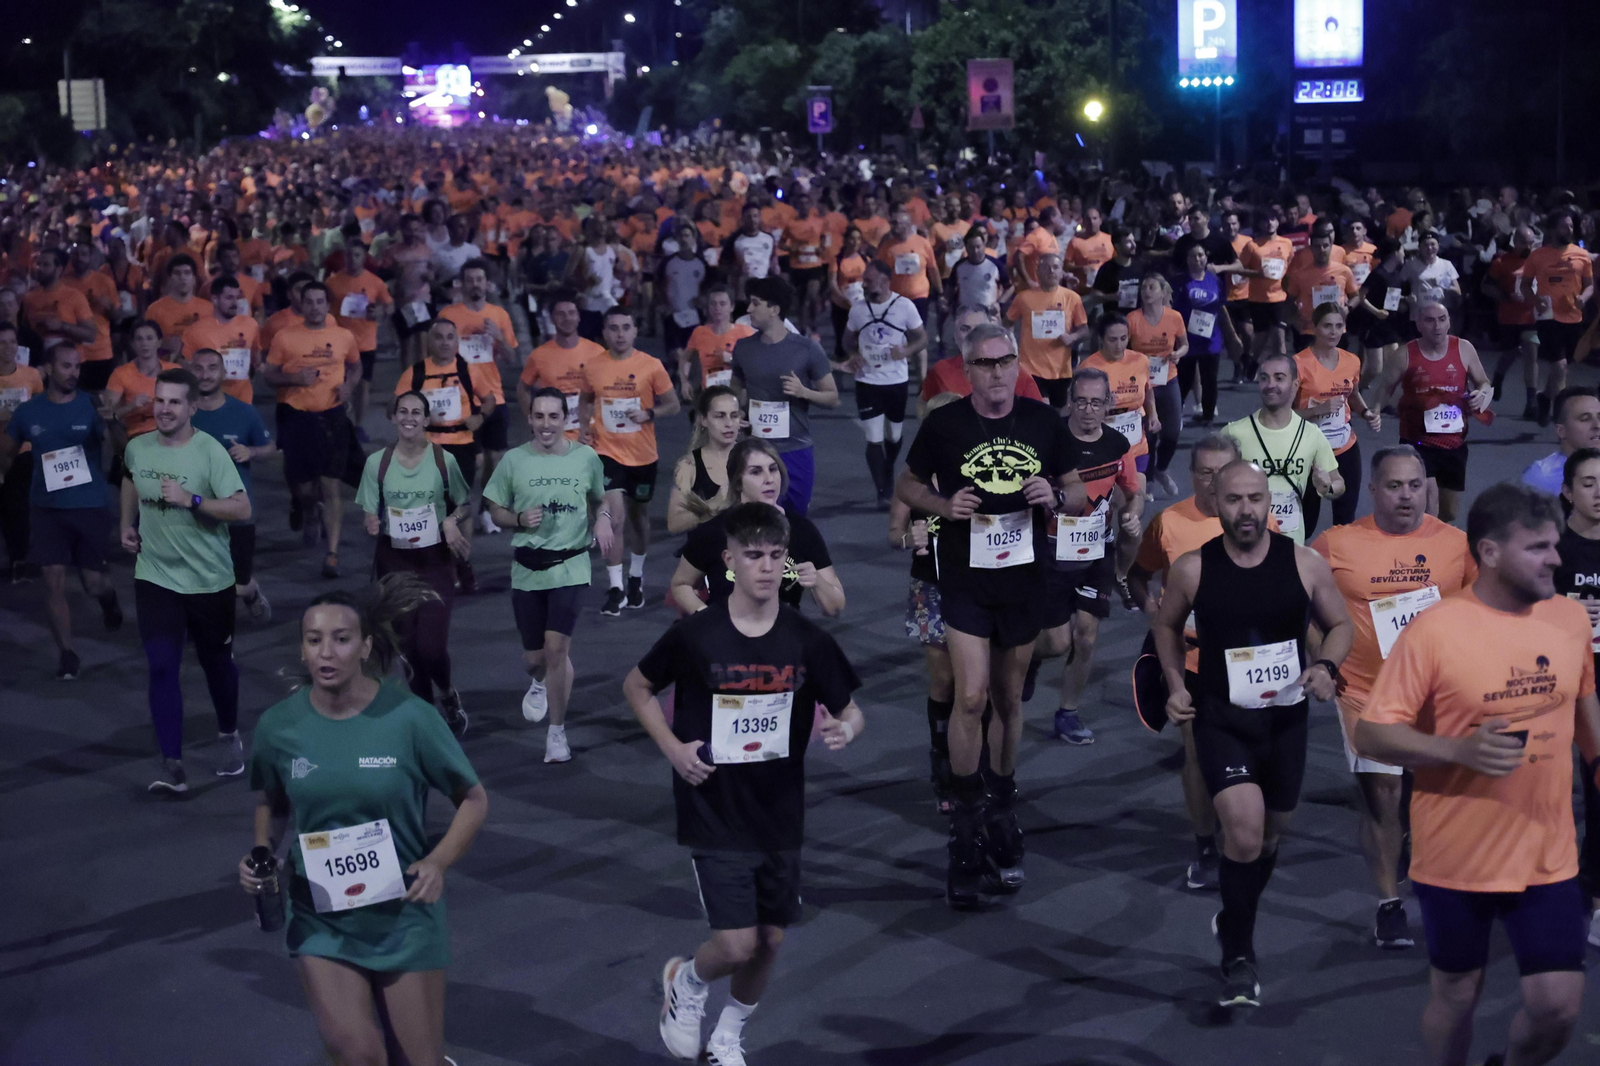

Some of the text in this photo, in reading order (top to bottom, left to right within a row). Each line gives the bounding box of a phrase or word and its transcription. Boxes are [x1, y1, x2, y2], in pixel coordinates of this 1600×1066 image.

[1193, 0, 1226, 47] P
[1298, 81, 1358, 98] 22:08
[1041, 319, 1057, 328] 7385
[758, 414, 778, 423] 4279
[1434, 411, 1458, 420] 21575
[1114, 423, 1136, 434] 7579
[1014, 439, 1037, 457] Sevilla
[53, 459, 80, 473] 19817
[528, 476, 571, 487] cabimer
[399, 521, 428, 533] 13497
[986, 530, 1022, 546] 10255
[1069, 531, 1099, 543] 17180
[1370, 574, 1430, 583] SEVILLA KH7
[1389, 568, 1431, 576] NOCTURNA
[1391, 610, 1422, 630] 144
[1246, 665, 1289, 684] 12199
[1506, 674, 1557, 688] NOCTURNA
[1483, 683, 1556, 702] SEVILLA KH7
[732, 716, 778, 734] 13395
[359, 756, 397, 765] NATACIÓN
[325, 850, 380, 877] 15698
